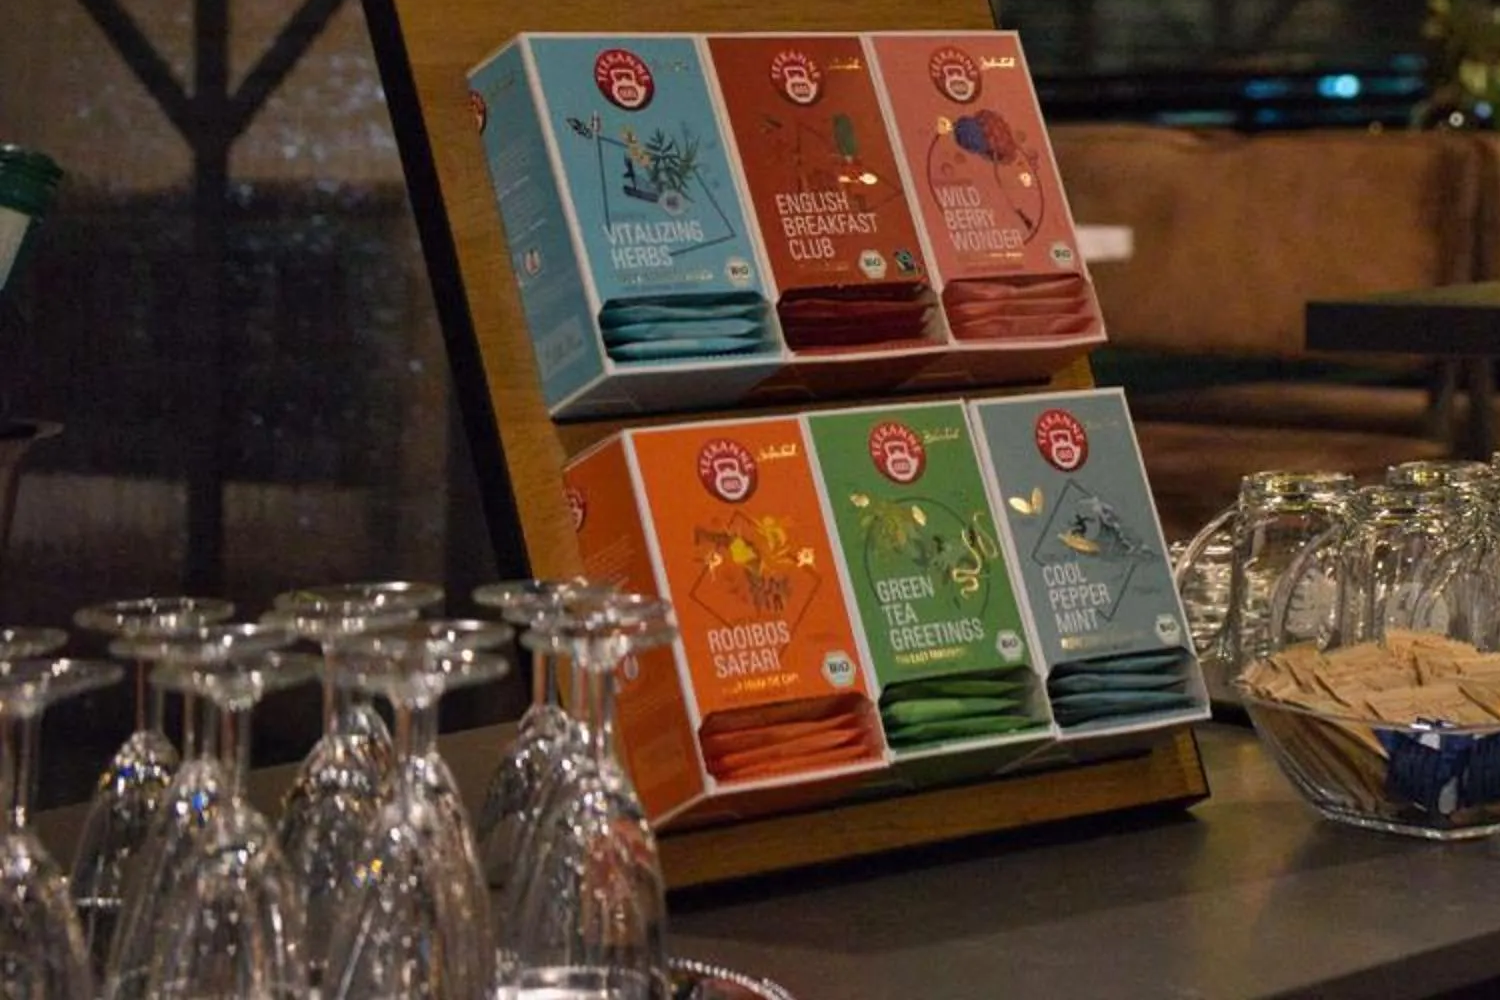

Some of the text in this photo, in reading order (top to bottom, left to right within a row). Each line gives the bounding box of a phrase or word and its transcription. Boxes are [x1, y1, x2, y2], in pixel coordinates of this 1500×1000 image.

[597, 51, 650, 82] TEEKANNE
[775, 191, 849, 214] ENGLISH
[936, 185, 982, 208] WILD
[783, 213, 878, 238] BREAKFAST
[943, 208, 996, 230] BERRY
[603, 220, 704, 245] VITALIZING
[950, 229, 1024, 251] WONDER
[610, 245, 674, 270] HERBS
[789, 238, 836, 260] CLUB
[872, 423, 922, 457] TEEKANNE
[1039, 412, 1085, 444] TEEKANNE
[701, 440, 755, 475] TEEKANNE
[1043, 562, 1088, 586] COOL
[876, 576, 935, 602] GREEN
[1050, 583, 1112, 610] PEPPER
[882, 603, 919, 626] TEA
[1055, 608, 1099, 633] MINT
[708, 621, 791, 653] ROOIBOS
[890, 618, 985, 651] GREETINGS
[714, 647, 782, 679] SAFARI
